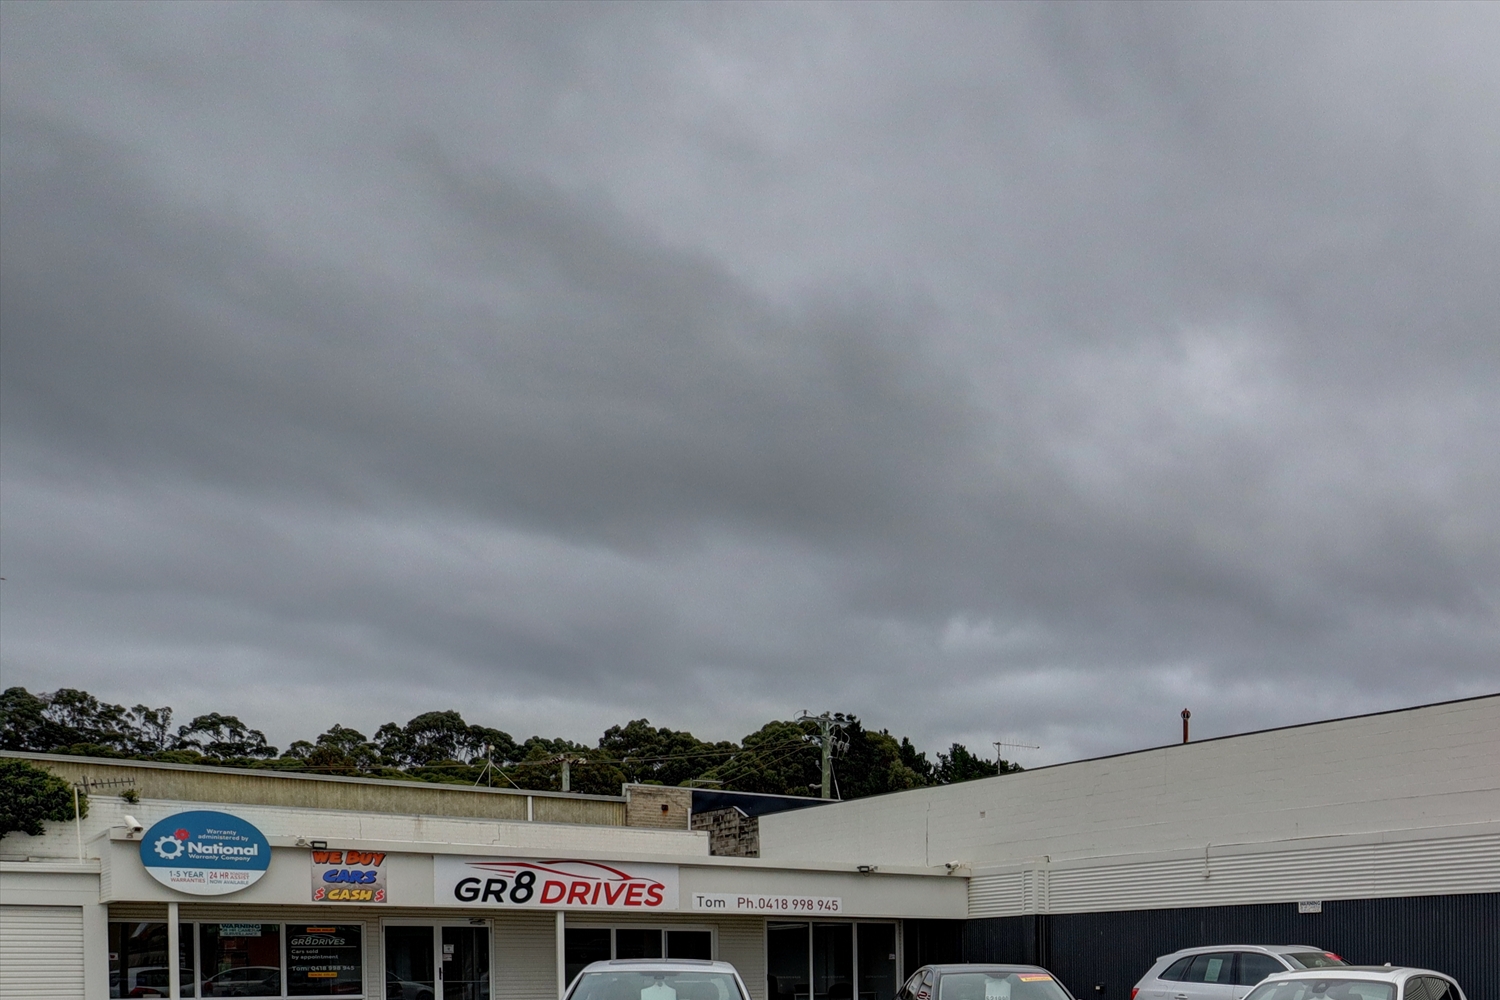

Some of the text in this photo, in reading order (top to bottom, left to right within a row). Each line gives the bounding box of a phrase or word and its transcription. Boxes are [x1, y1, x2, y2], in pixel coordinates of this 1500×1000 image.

[206, 828, 237, 836] Warranty
[187, 842, 258, 856] National
[188, 853, 251, 863] Warranty Company
[312, 850, 386, 867] WE BUY
[209, 871, 218, 879] 24
[322, 869, 377, 884] CARS
[314, 887, 385, 902] $ CASH $
[454, 870, 666, 907] GR8 DRIVES
[696, 895, 839, 911] Tom Ph.0418 998 945
